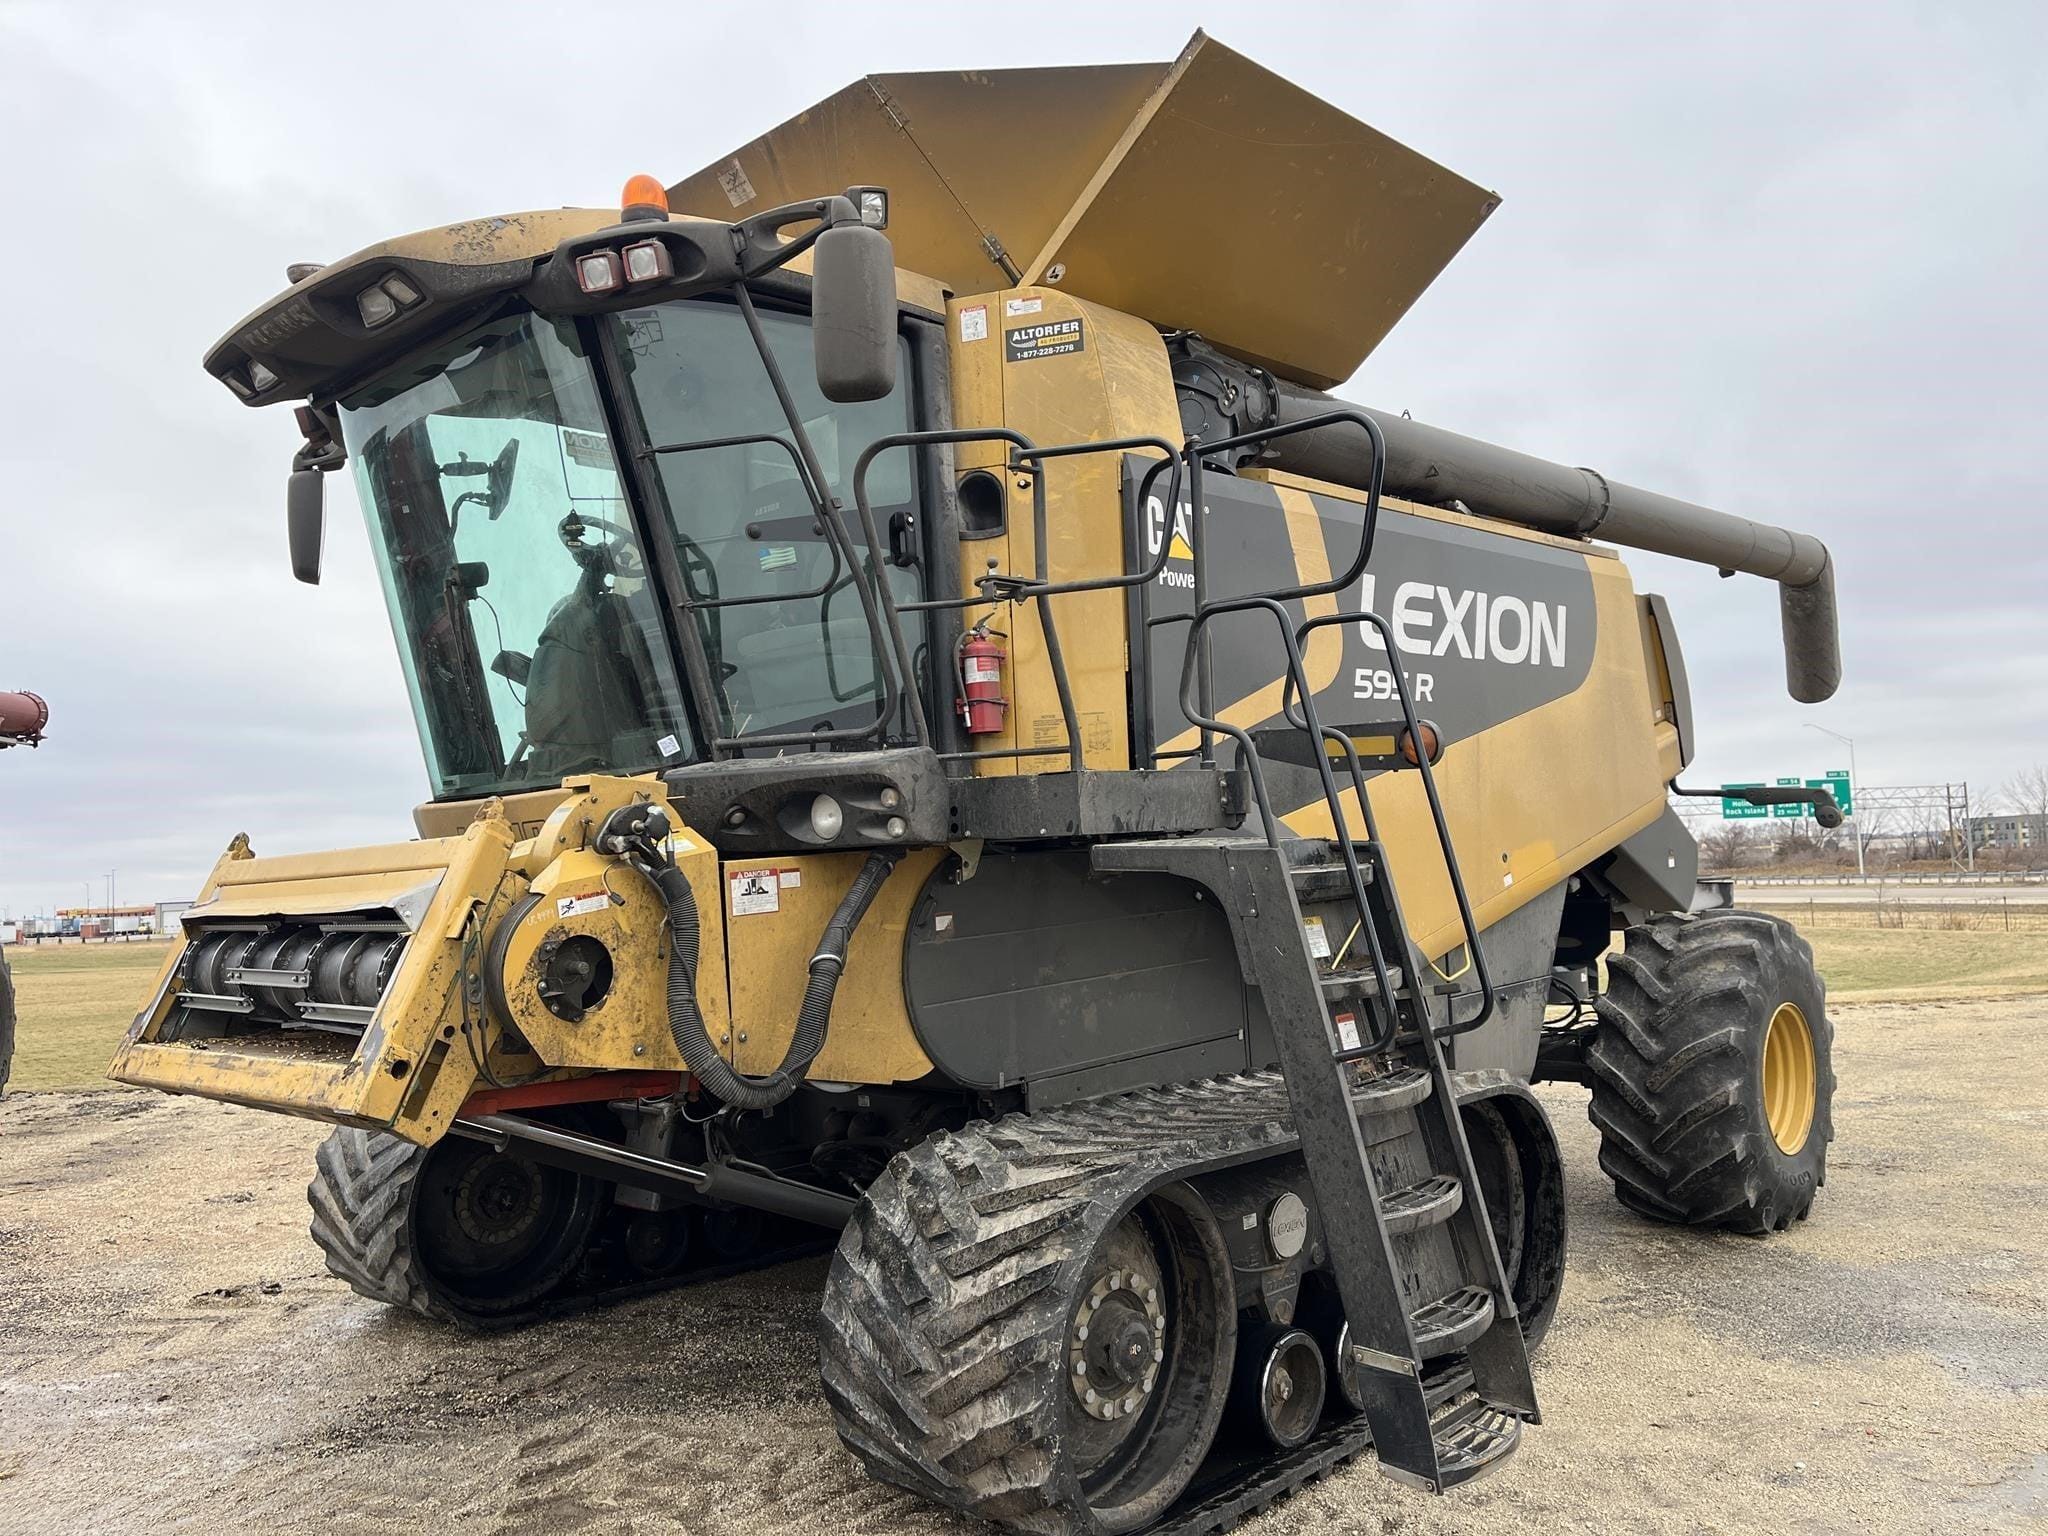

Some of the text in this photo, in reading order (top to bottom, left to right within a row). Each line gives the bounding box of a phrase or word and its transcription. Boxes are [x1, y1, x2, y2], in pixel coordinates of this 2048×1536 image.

[1012, 321, 1079, 341] ALTORFER
[1159, 566, 1195, 589] Powe
[1359, 573, 1567, 668] LEXION
[1415, 673, 1434, 702] R
[743, 870, 770, 878] DANGER
